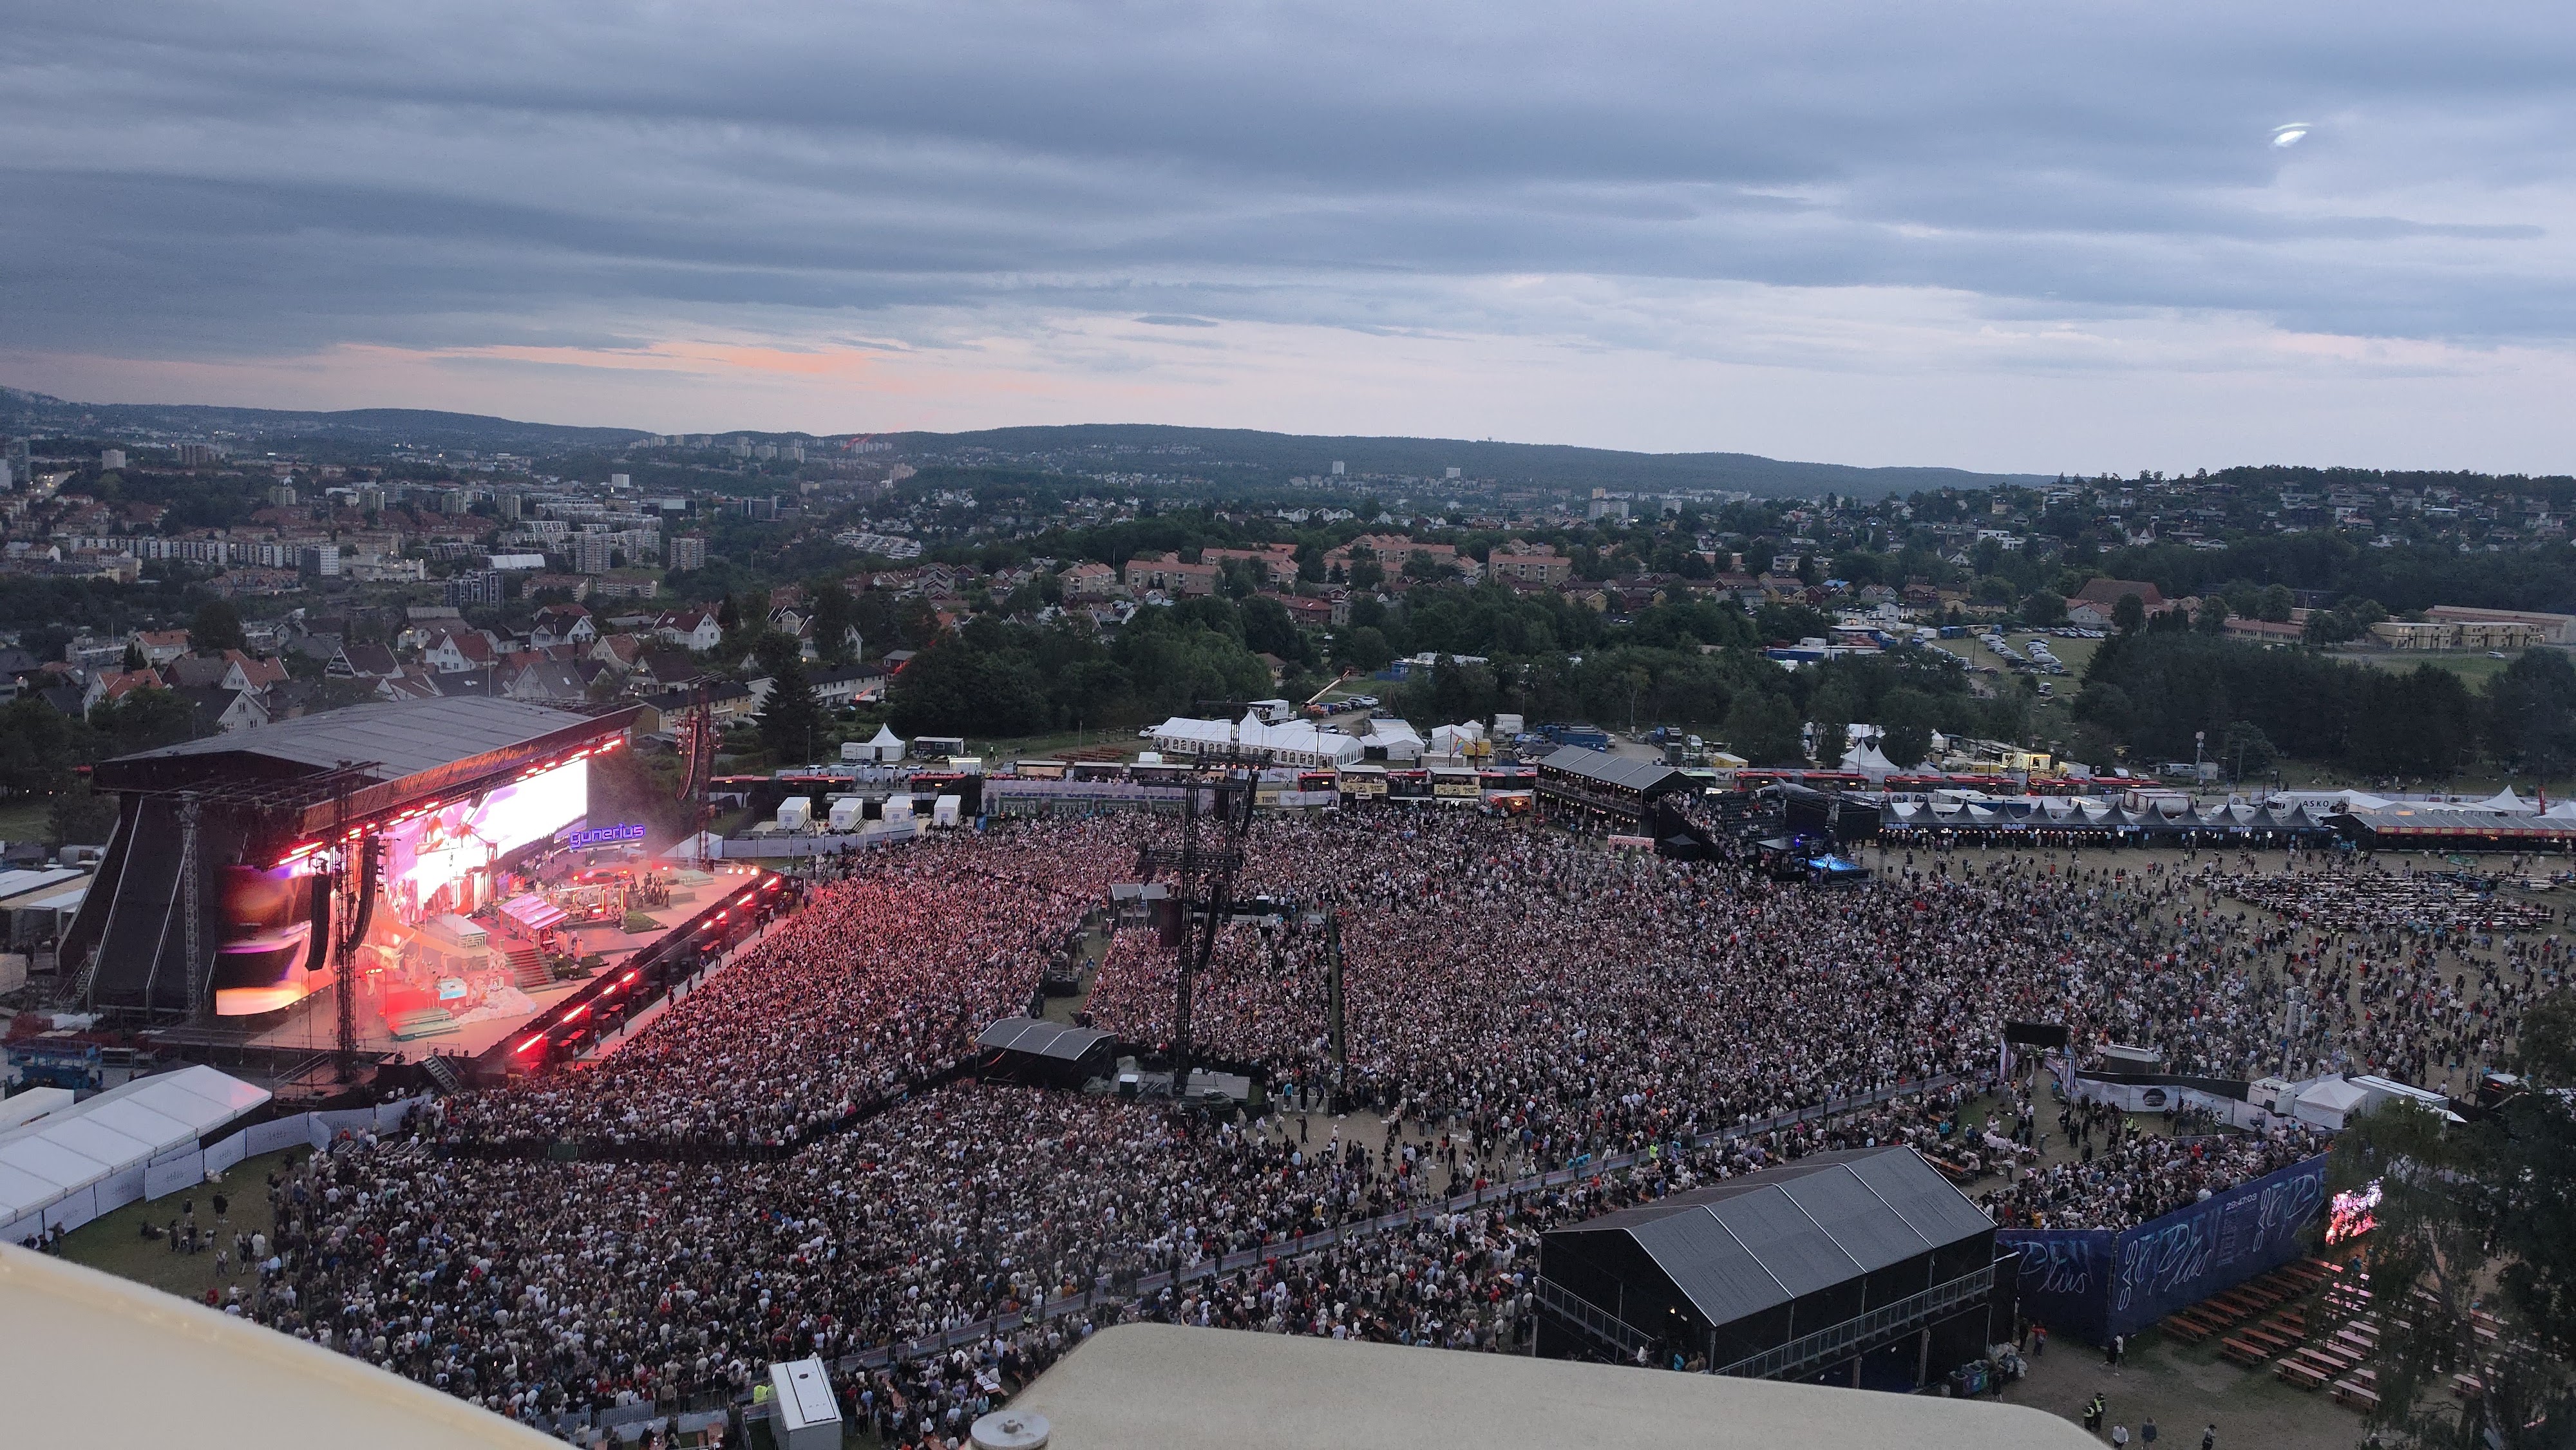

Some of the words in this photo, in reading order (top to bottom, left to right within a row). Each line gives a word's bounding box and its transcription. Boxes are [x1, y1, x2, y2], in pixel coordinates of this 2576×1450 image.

[1003, 804, 1027, 813] EXIT
[1054, 804, 1077, 814] EXIT
[570, 822, 645, 849] gunerius
[2013, 1241, 2088, 1294] Plus
